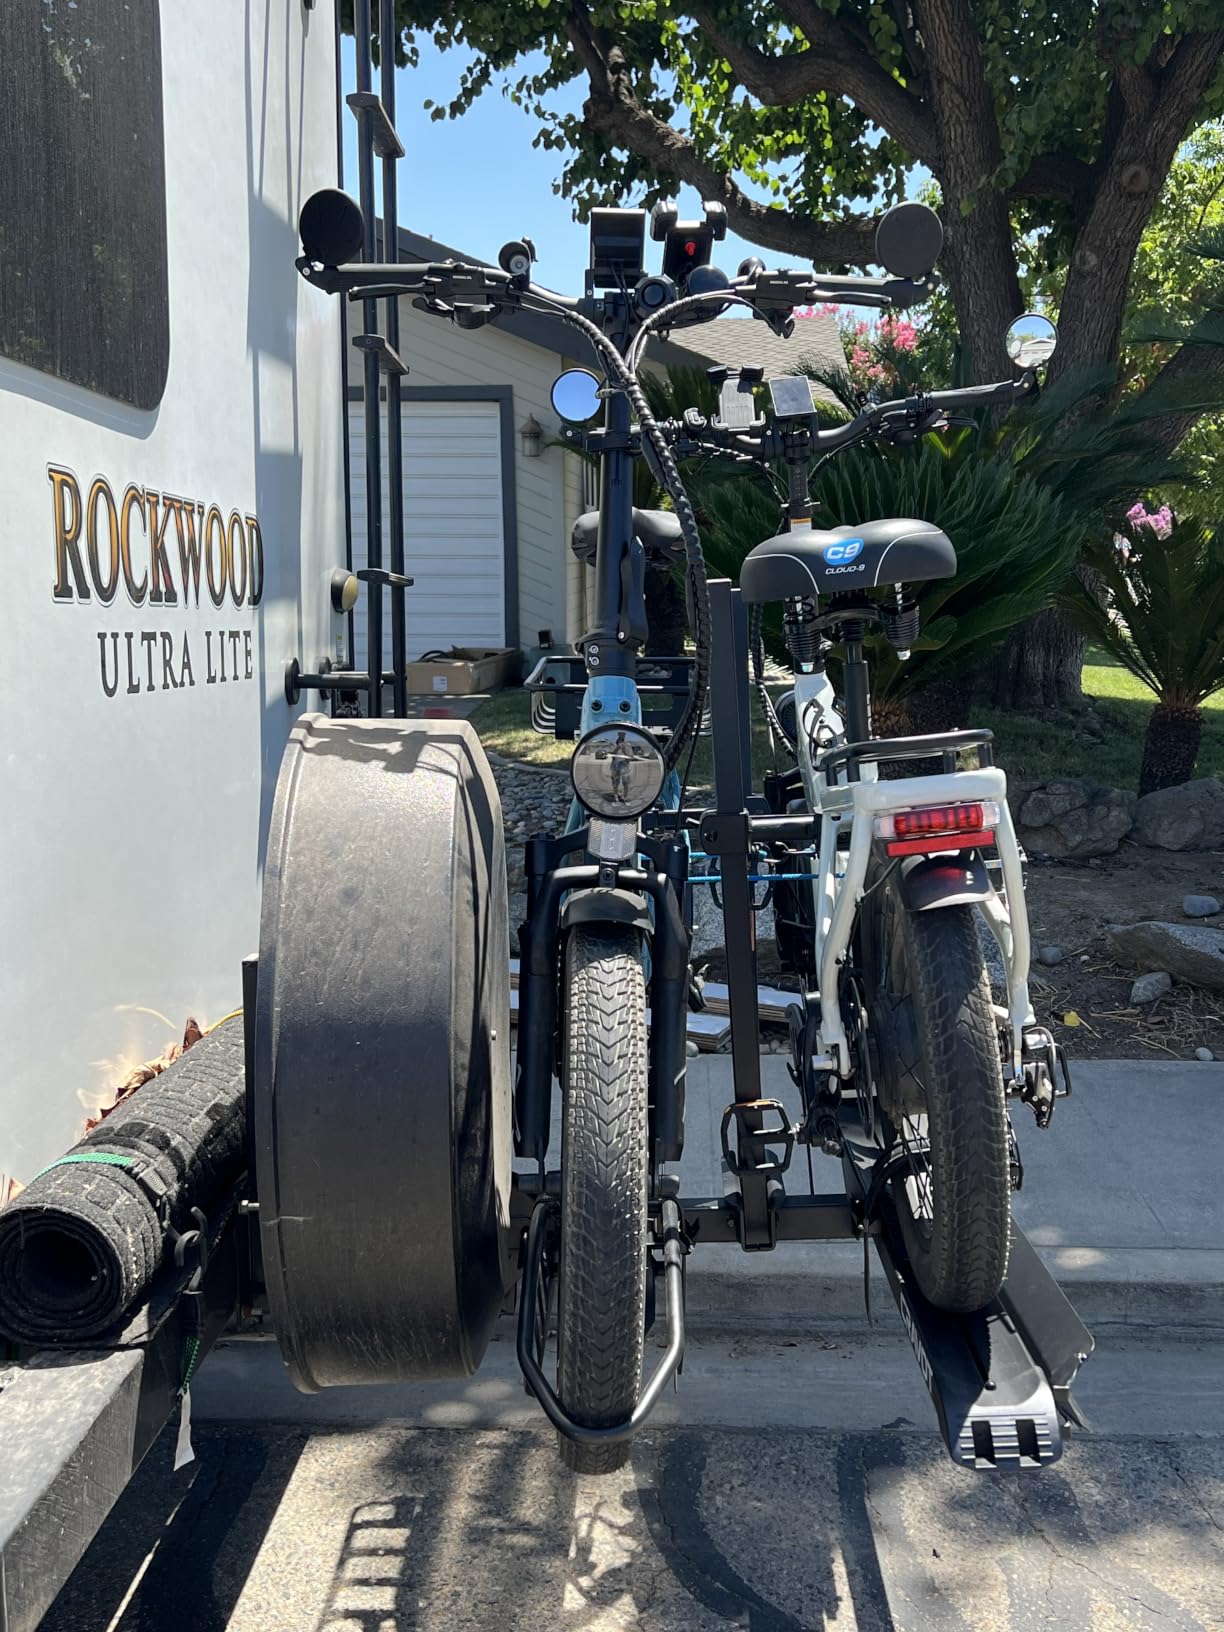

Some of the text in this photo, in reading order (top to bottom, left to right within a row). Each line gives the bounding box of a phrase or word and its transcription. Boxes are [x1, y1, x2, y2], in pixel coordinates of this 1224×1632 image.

[47, 463, 264, 609] ROCKWOOD
[826, 542, 860, 559] C9
[825, 564, 866, 575] CLOUD-9
[97, 629, 253, 697] ULTRA LITE
